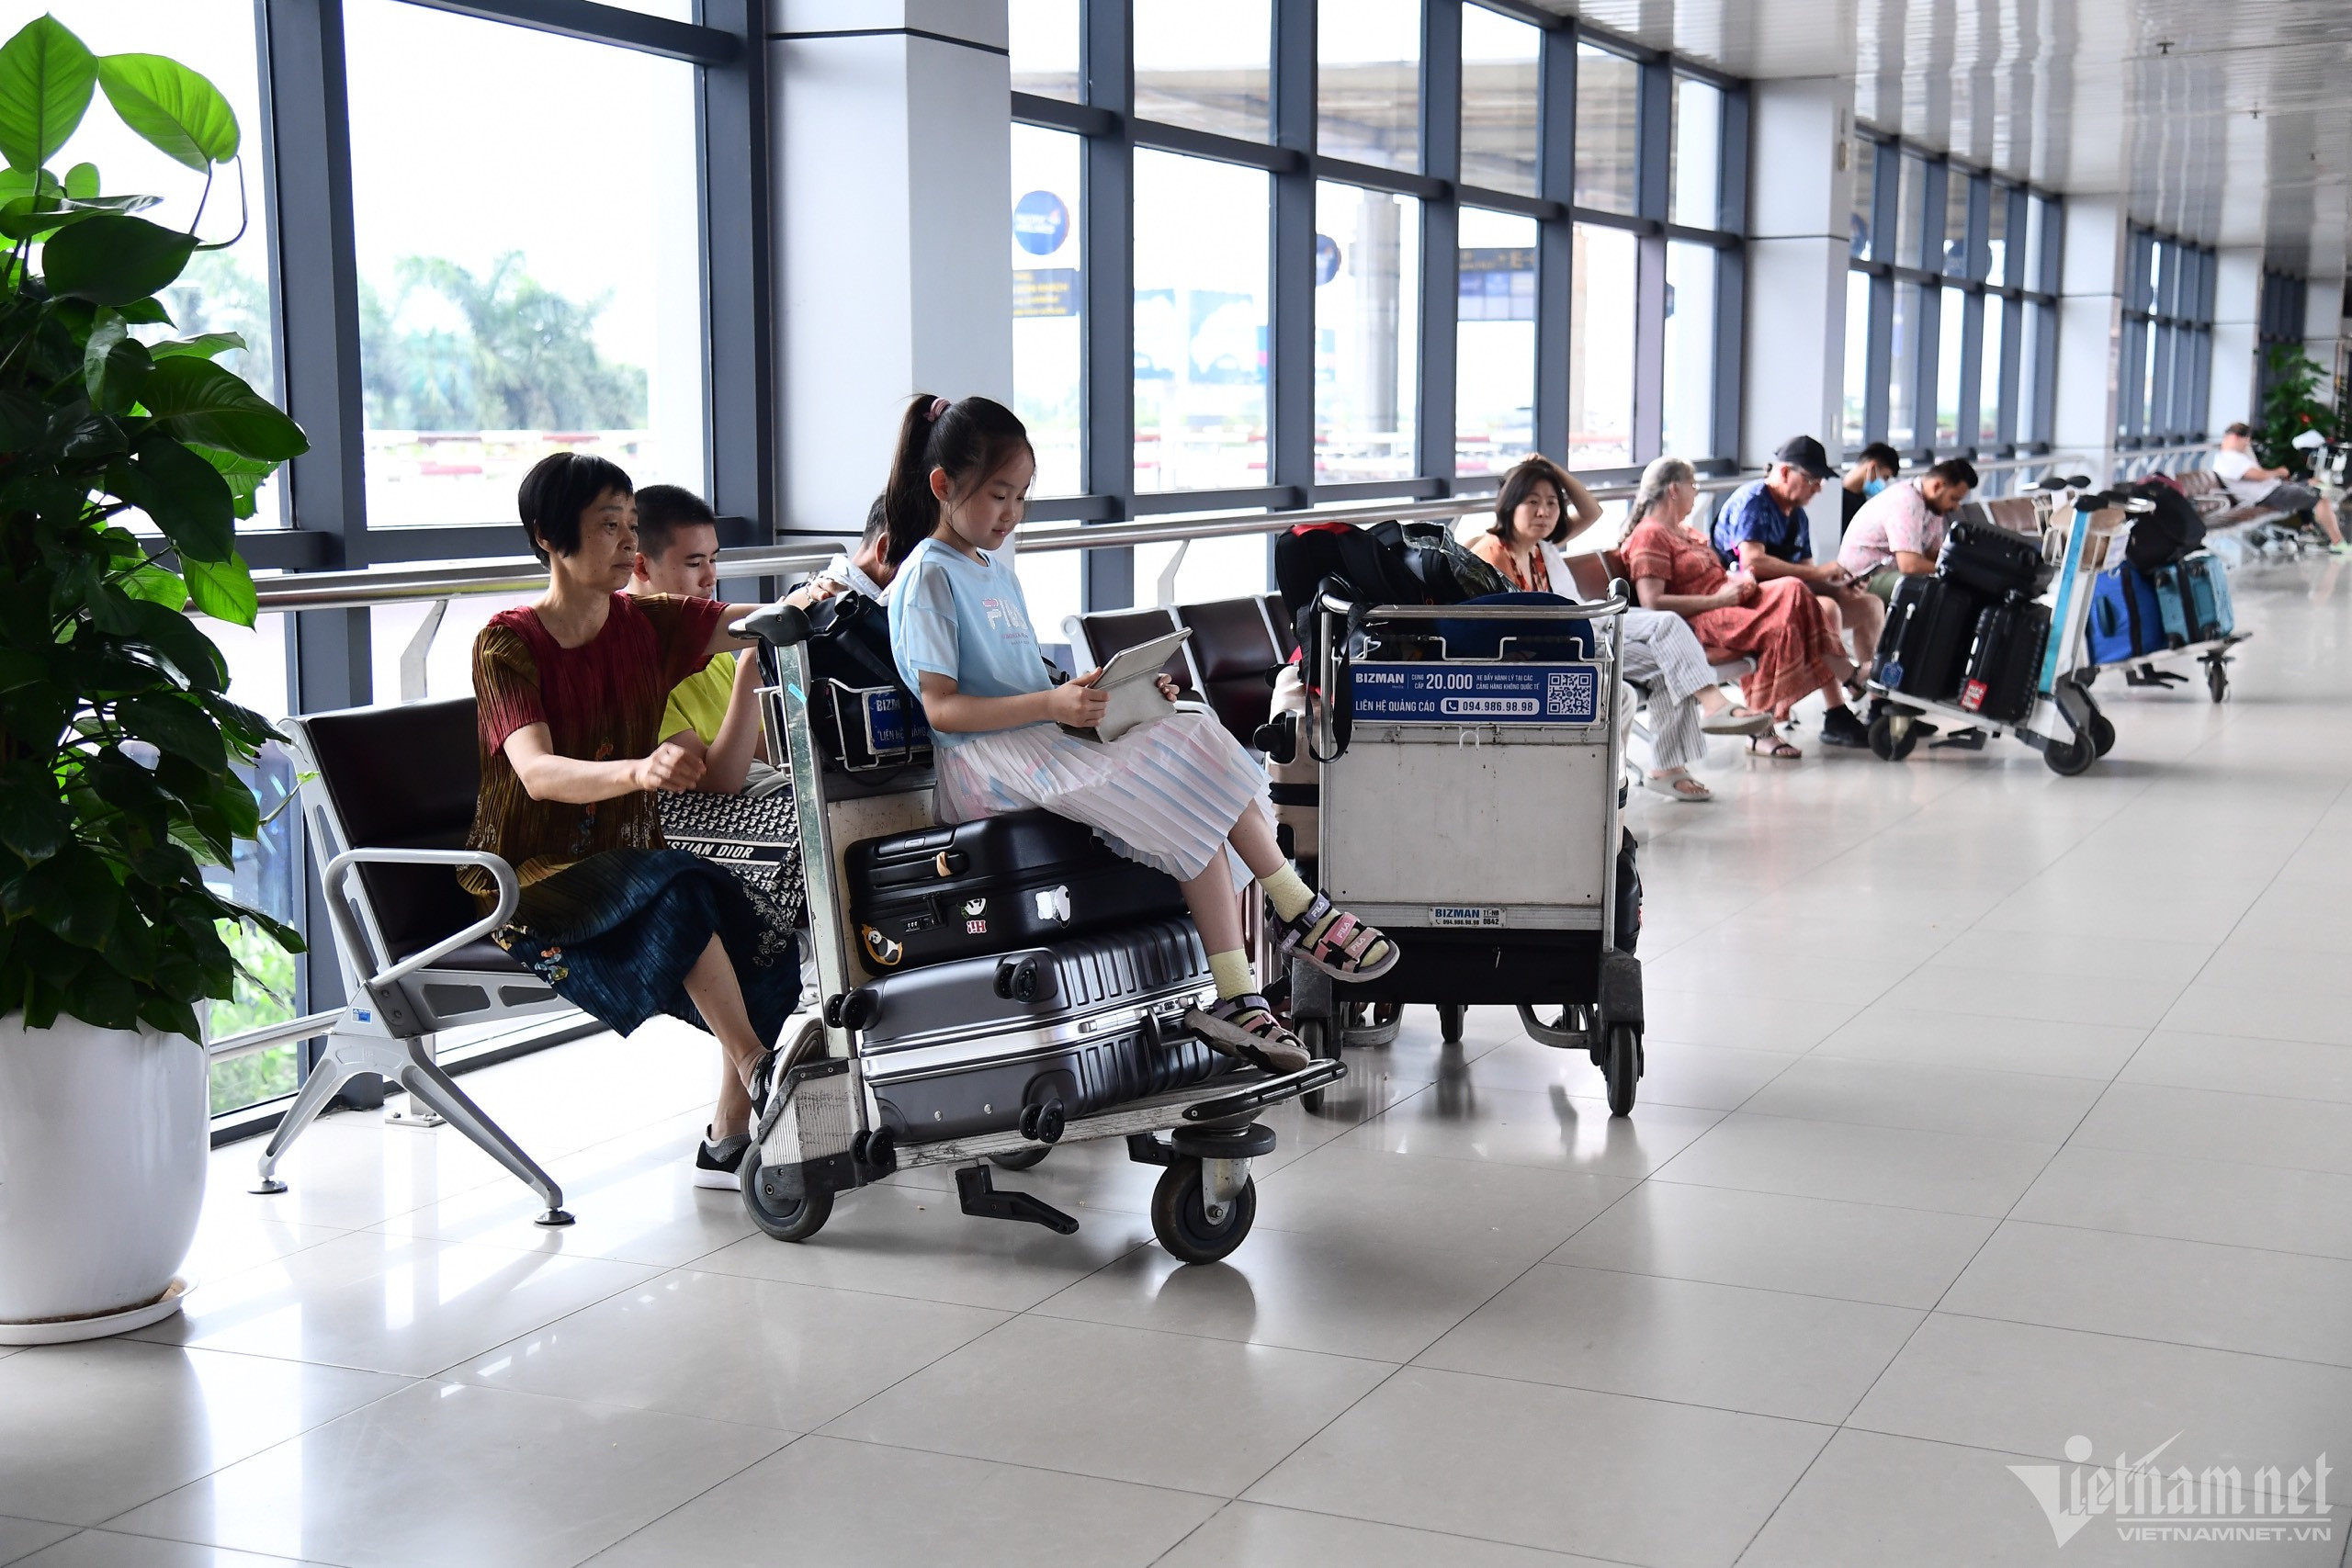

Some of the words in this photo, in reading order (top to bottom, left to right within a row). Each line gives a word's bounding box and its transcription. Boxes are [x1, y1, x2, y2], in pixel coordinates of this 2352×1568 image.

[1355, 673, 1404, 683] BIZMAN
[1426, 673, 1473, 690] 20.000
[1355, 699, 1374, 711] LIÊN
[1375, 699, 1386, 713] HỆ
[1389, 698, 1416, 712] QUẢNG
[1419, 700, 1435, 712] CÁO
[1463, 701, 1533, 712] 094.986.98.98
[716, 845, 754, 859] DIOR
[1311, 901, 1325, 918] FILA
[1435, 908, 1480, 918] BIZMAN
[967, 920, 986, 933] Hi!
[1337, 922, 1351, 938] FILA
[1351, 937, 1366, 952] FILA
